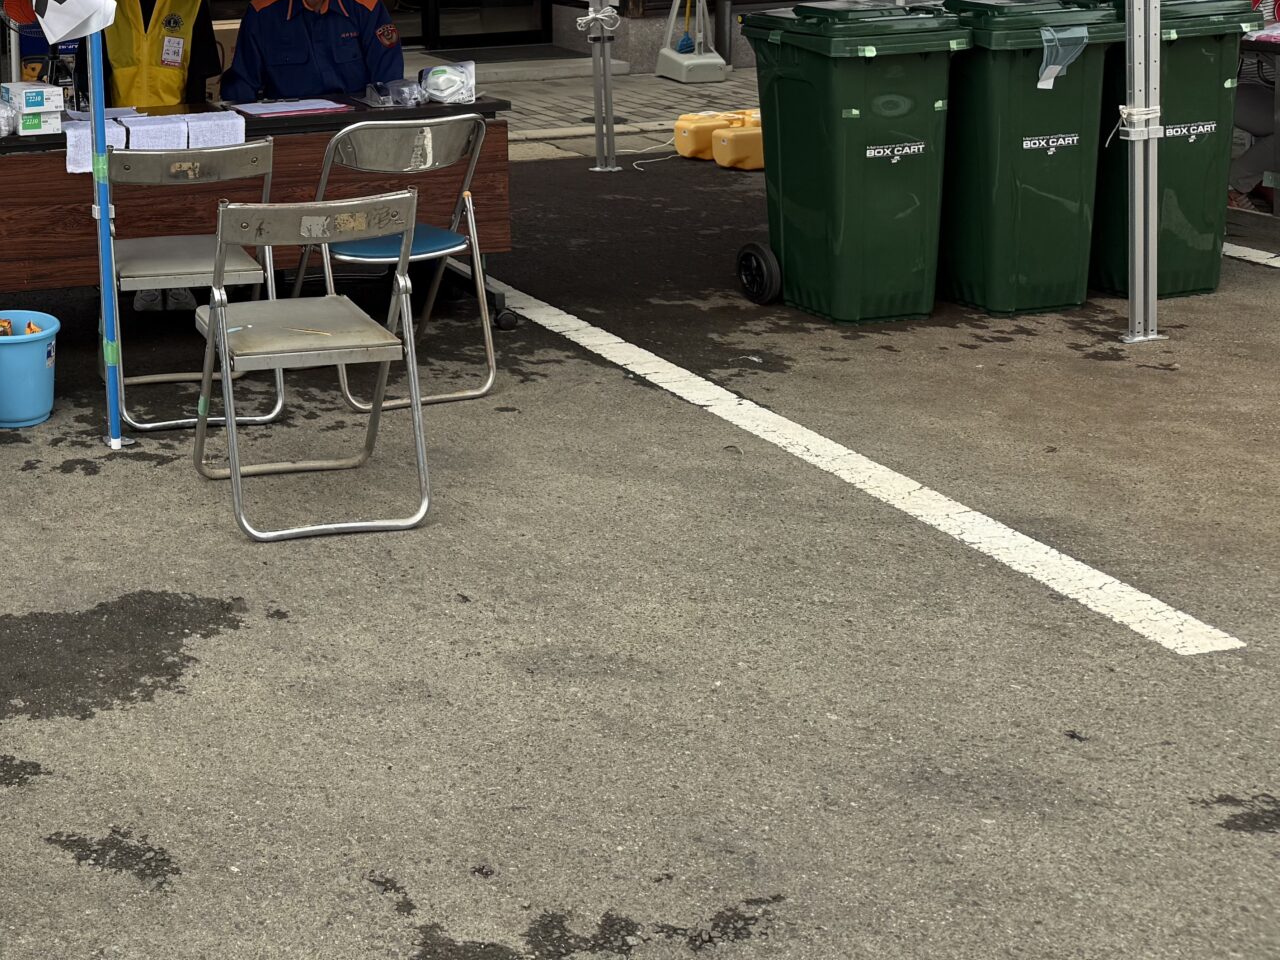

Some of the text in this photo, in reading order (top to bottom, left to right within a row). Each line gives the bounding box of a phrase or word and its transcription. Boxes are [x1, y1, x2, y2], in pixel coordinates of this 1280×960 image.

[1166, 123, 1217, 137] BOX CART
[1023, 136, 1079, 149] BOX CART
[866, 144, 925, 157] BOX CART
